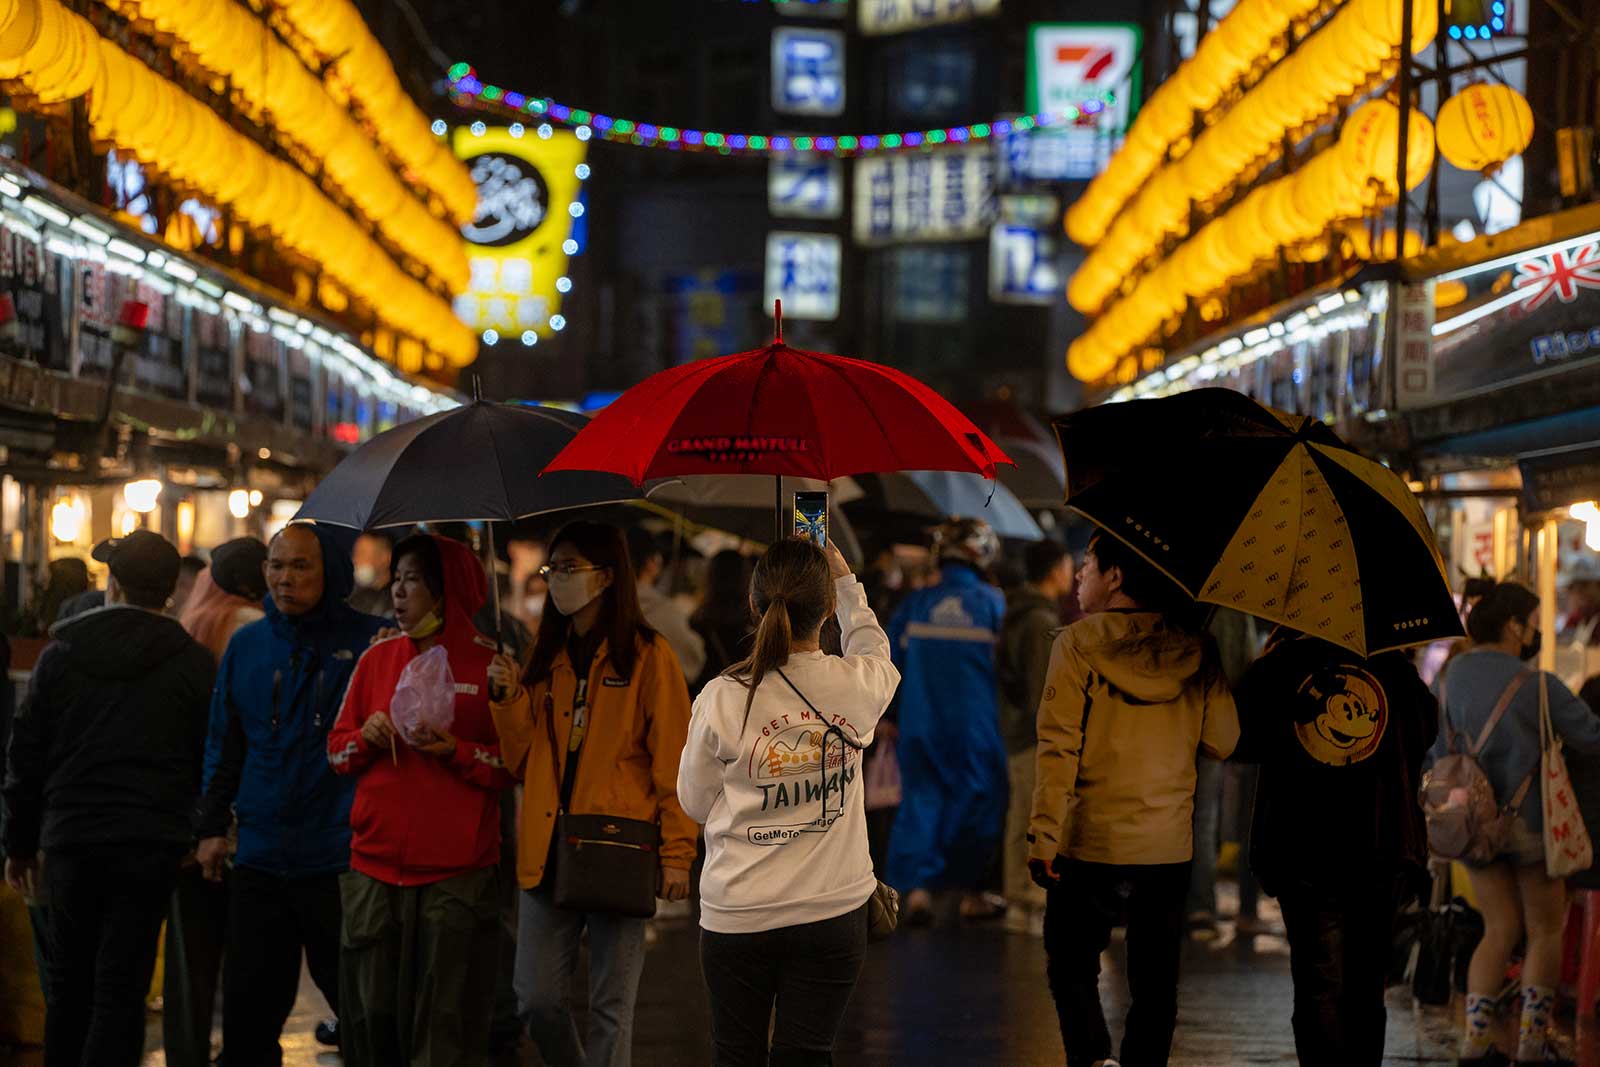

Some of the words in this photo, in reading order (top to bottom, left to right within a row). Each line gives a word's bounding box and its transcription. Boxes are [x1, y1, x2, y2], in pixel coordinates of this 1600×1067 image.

[1056, 45, 1114, 81] 7
[1126, 516, 1169, 551] VOLVO
[1328, 564, 1342, 575] 1927
[1321, 592, 1335, 603] 1927
[1393, 617, 1429, 631] VOLVO
[762, 714, 790, 737] GET
[831, 713, 847, 726] TO
[756, 763, 855, 812] TAIWAN
[753, 829, 800, 841] GetMeTo
